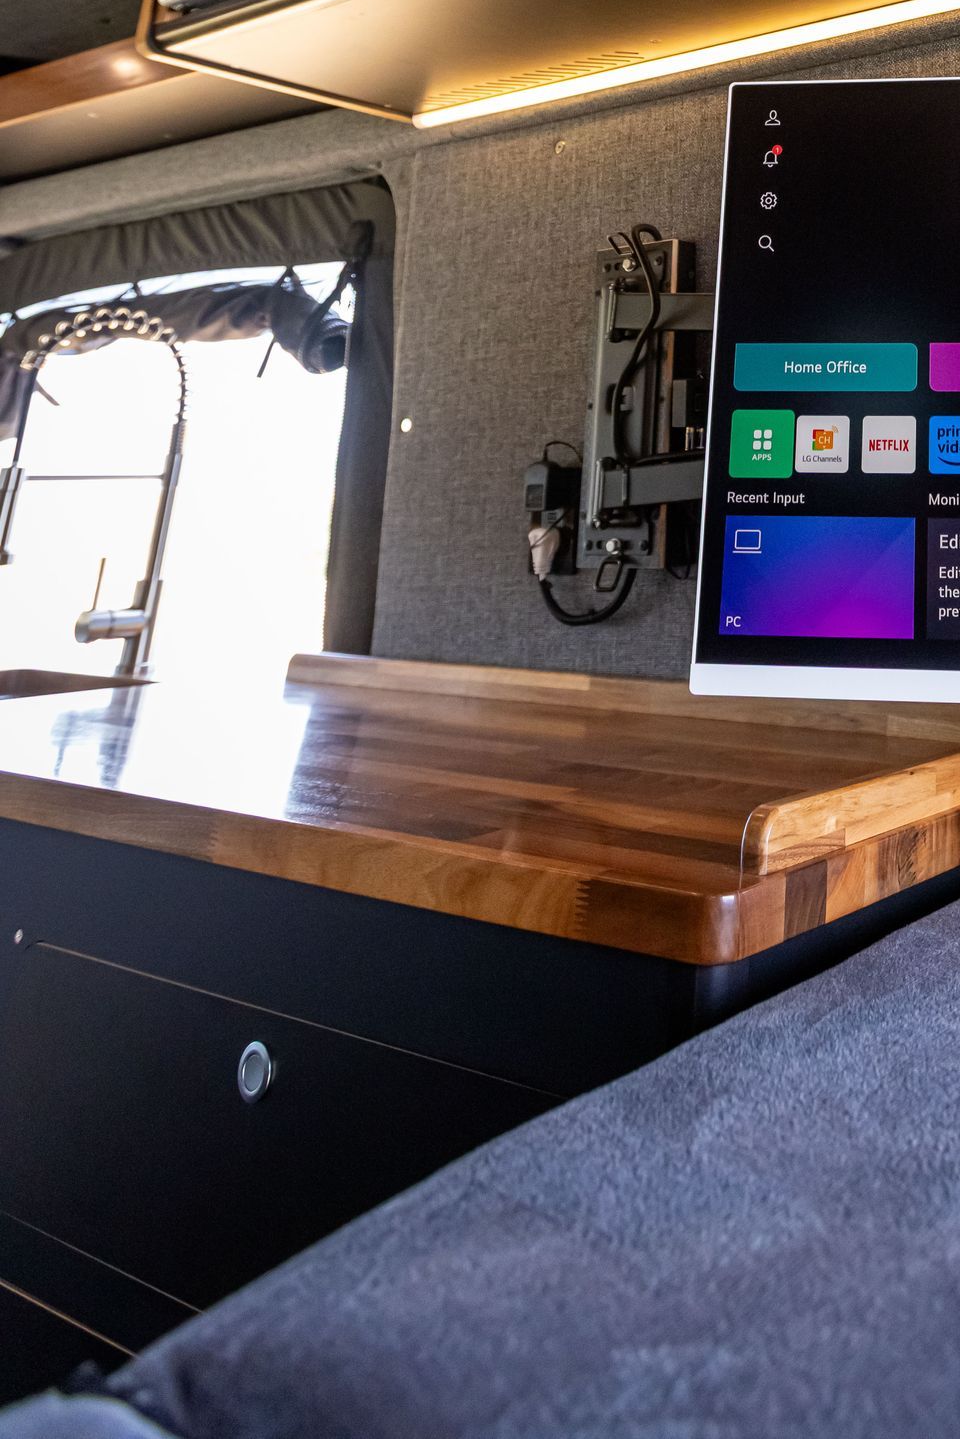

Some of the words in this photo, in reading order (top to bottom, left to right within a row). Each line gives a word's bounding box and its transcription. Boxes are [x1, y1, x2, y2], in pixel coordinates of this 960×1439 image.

[784, 361, 822, 373] Home
[826, 361, 867, 373] Office
[818, 435, 831, 445] CH
[869, 439, 909, 452] NETFLIX
[752, 453, 772, 461] APPS
[802, 455, 812, 463] LG
[812, 455, 842, 463] Channels
[727, 492, 769, 504] Recent
[773, 492, 805, 507] Input
[939, 586, 960, 598] the
[726, 616, 741, 627] PC
